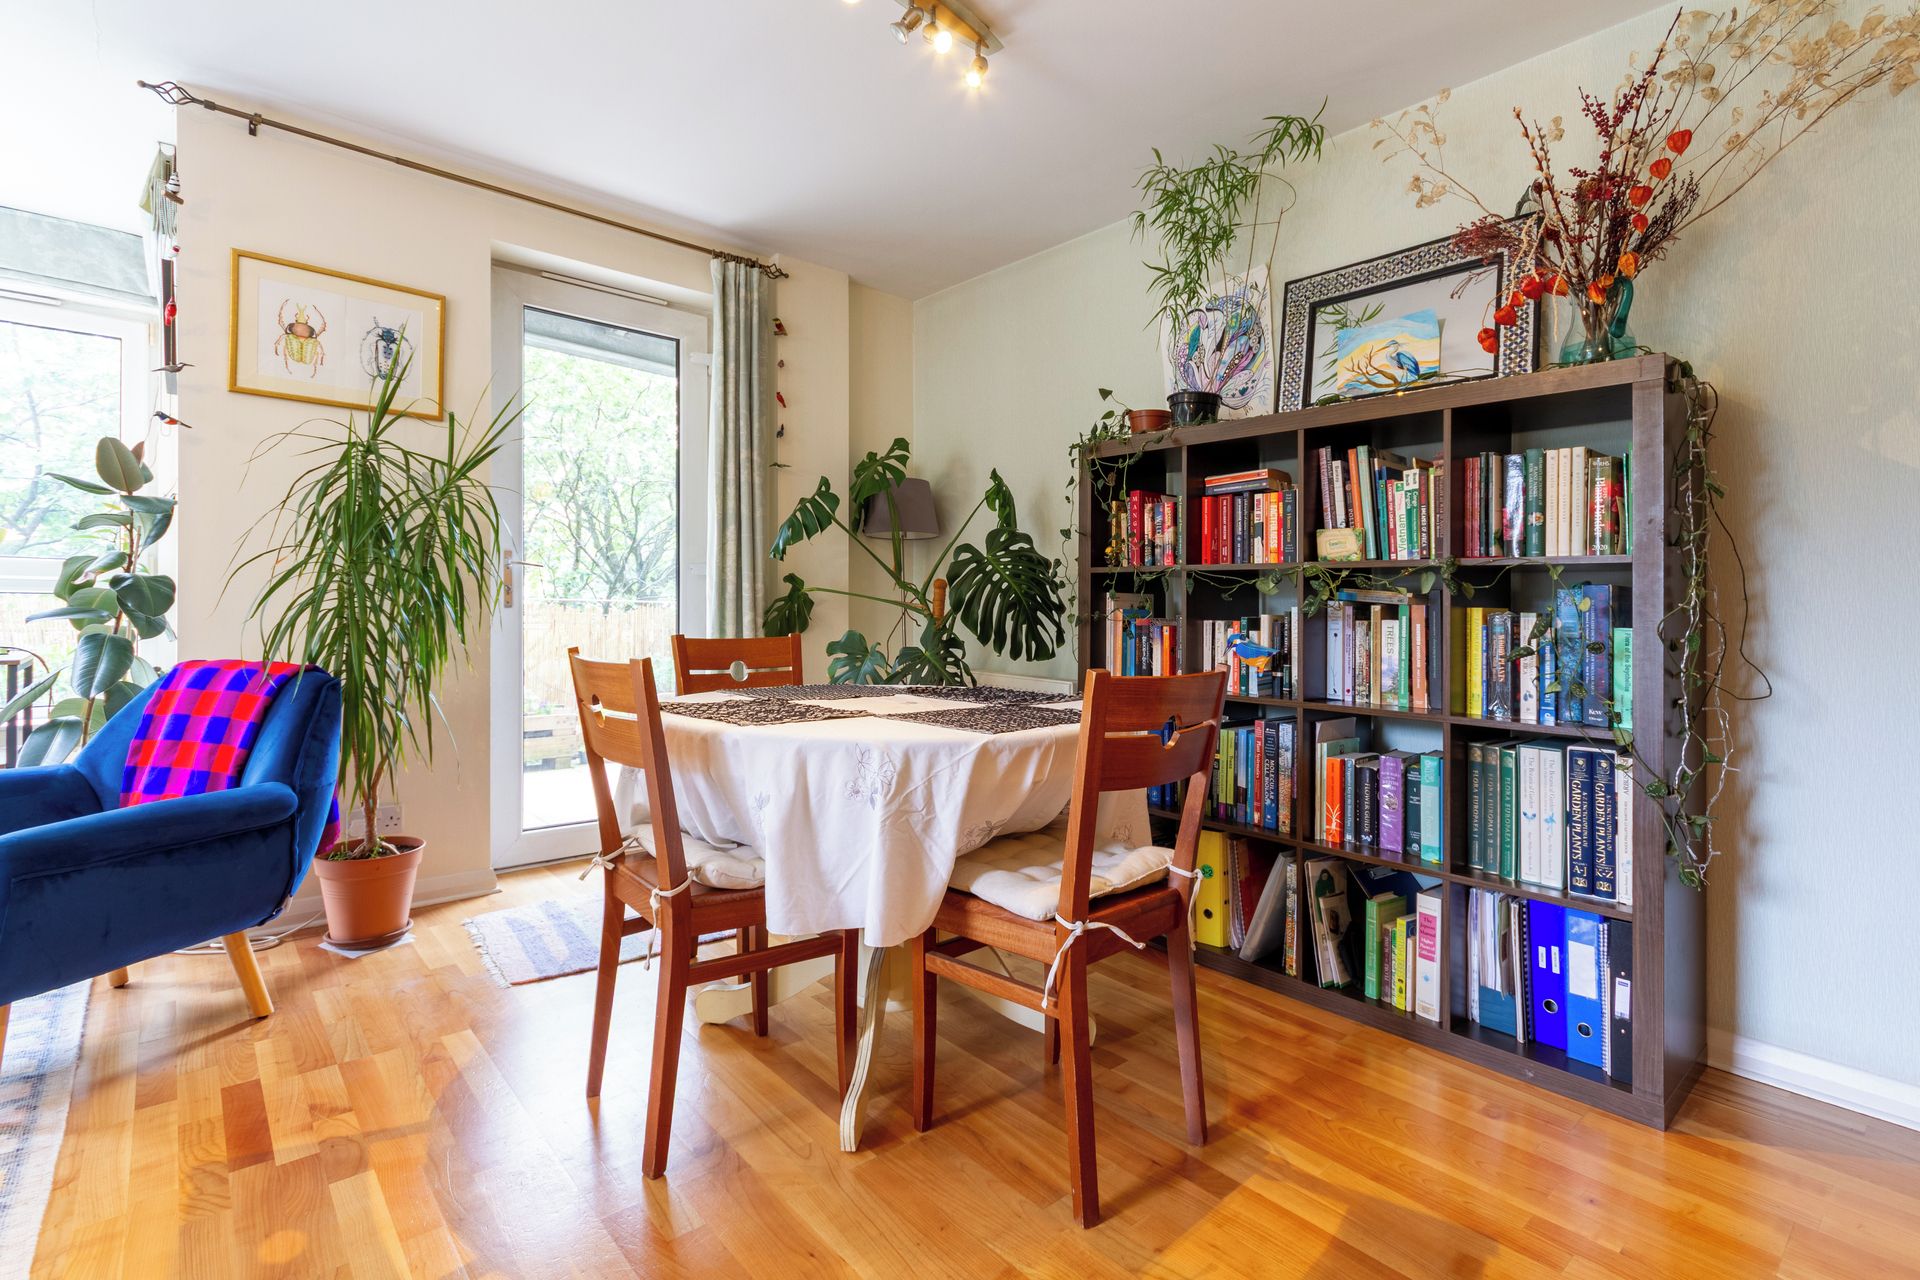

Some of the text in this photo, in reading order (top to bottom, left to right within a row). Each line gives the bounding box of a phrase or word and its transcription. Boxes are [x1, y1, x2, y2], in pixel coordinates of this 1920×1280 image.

[1270, 503, 1278, 548] FACTFULNESS
[1594, 477, 1605, 538] Plant Finder
[1398, 513, 1406, 552] Vietnam
[1386, 625, 1394, 655] TREES
[1572, 780, 1582, 860] GARDEN PLANTS
[1595, 783, 1606, 864] GARDEN PLANTS
[1573, 865, 1587, 876] A-J
[1596, 869, 1614, 879] K-Z
